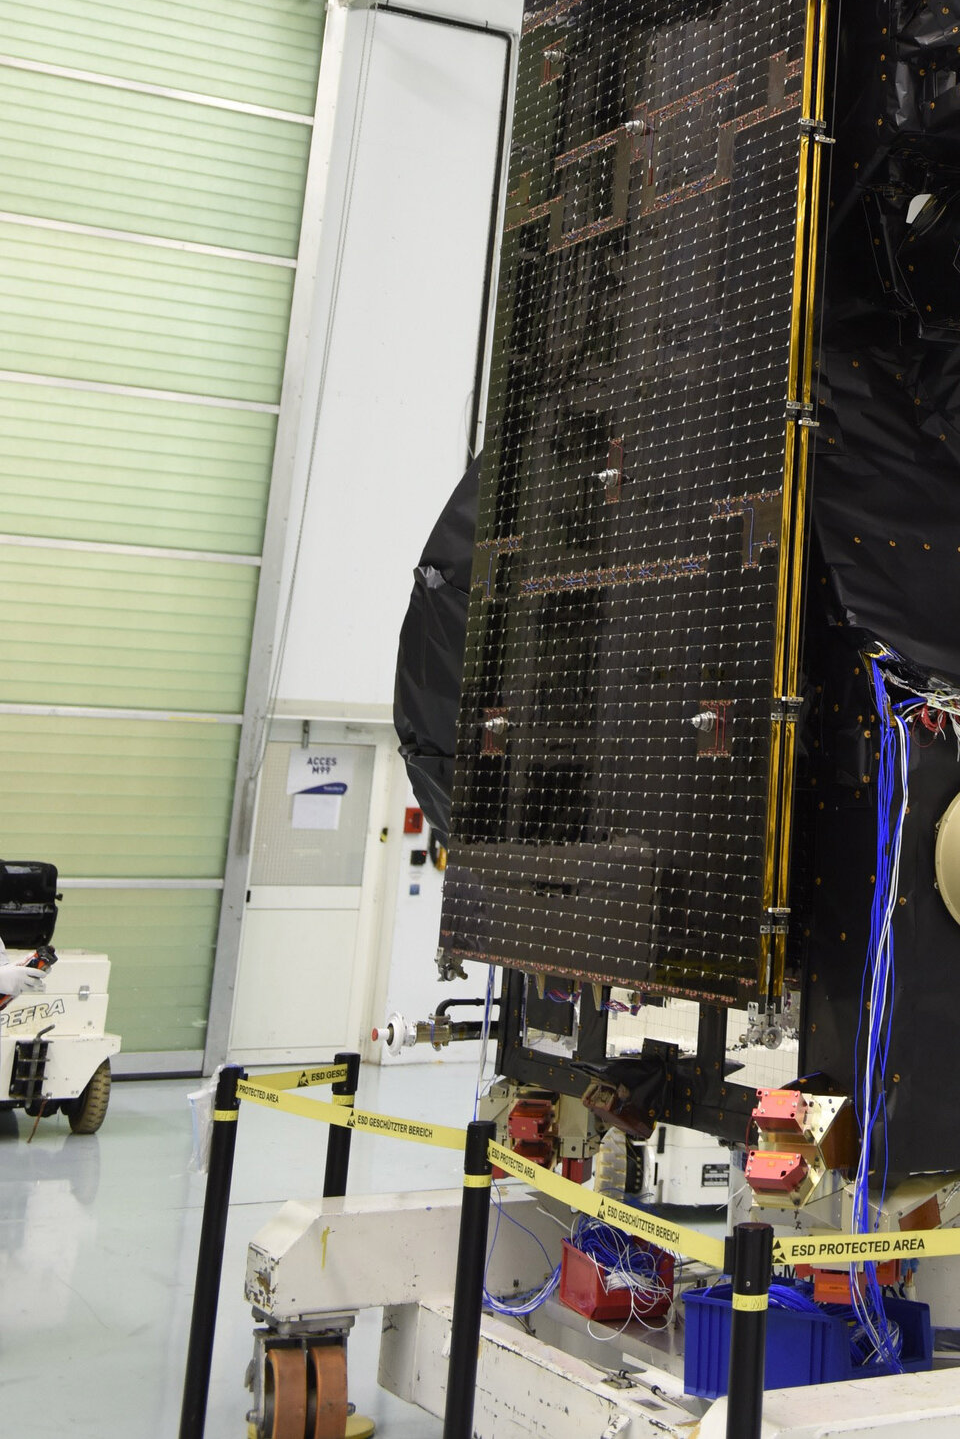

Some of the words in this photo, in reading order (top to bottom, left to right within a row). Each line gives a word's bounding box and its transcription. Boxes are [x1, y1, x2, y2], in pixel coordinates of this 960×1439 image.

[306, 757, 337, 766] ACCES
[311, 1071, 325, 1081] ESD
[239, 1084, 266, 1099] PROTECTED
[266, 1093, 279, 1103] AREA
[357, 1114, 369, 1125] ESD
[369, 1117, 408, 1133] GESCHÜTZTER
[408, 1125, 433, 1138] BEREICH
[491, 1147, 500, 1160] ESD
[500, 1152, 524, 1174] PROTECTED
[524, 1165, 536, 1180] AREA
[607, 1205, 617, 1219] ESD
[618, 1210, 655, 1235] GESCHÜTZTER
[655, 1225, 680, 1244] BEREICH
[791, 1244, 815, 1257] ESD
[819, 1240, 890, 1256] PROTECTED
[893, 1238, 925, 1251] AREA
